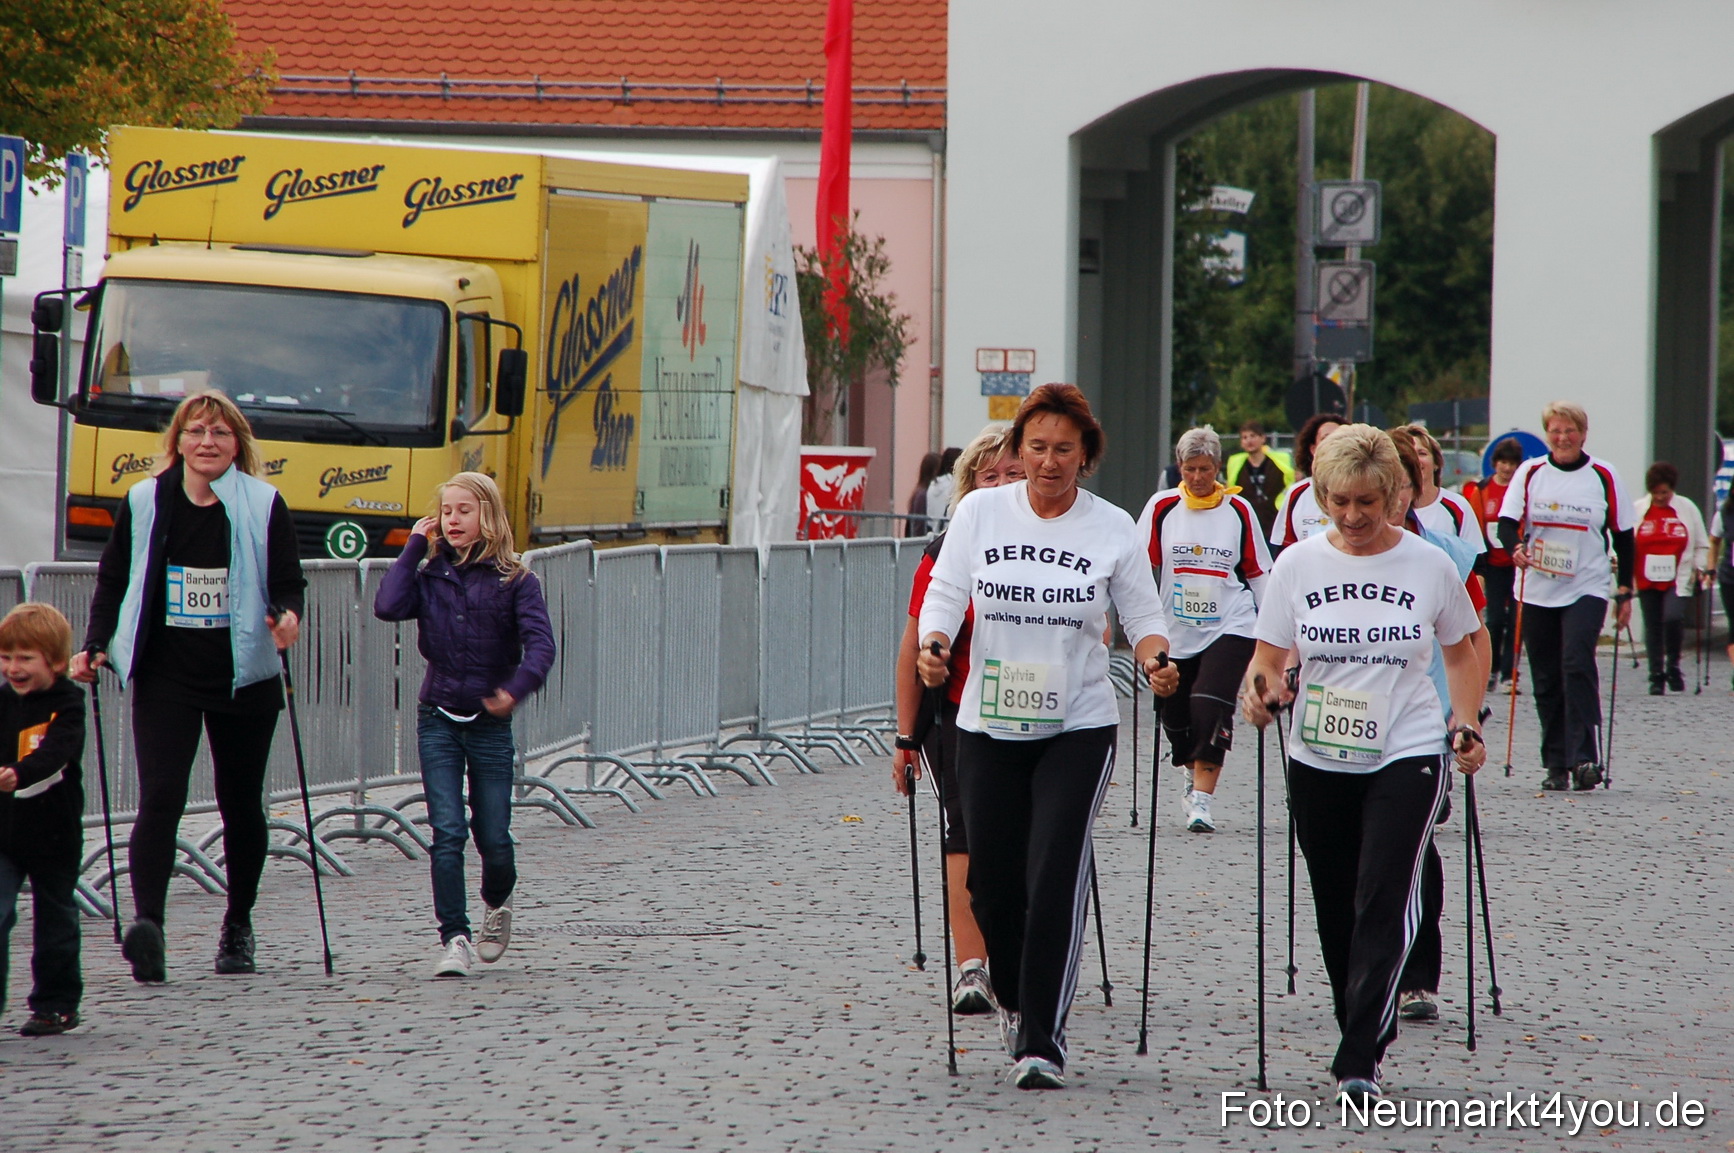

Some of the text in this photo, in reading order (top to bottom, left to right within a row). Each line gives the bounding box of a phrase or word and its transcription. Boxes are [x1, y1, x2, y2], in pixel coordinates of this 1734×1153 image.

[123, 155, 246, 212] Glossner
[263, 164, 385, 221] Glossner
[69, 166, 82, 233] P
[402, 173, 525, 229] Glossner
[541, 244, 642, 481] Glossner
[318, 463, 392, 498] Glossner
[338, 529, 357, 554] G
[984, 545, 1092, 575] BERGER
[1543, 555, 1572, 570] 8038
[186, 573, 227, 585] Barbara
[977, 579, 1096, 603] POWER GIRLS
[187, 591, 230, 608] 801
[1185, 602, 1218, 613] 8028
[1305, 583, 1416, 611] BERGER
[984, 612, 1084, 629] walking and talking
[1301, 624, 1421, 643] POWER GIRLS
[1308, 654, 1409, 669] walking and talking
[1003, 666, 1035, 683] Sylvia
[1004, 689, 1059, 710] 8095
[1326, 691, 1369, 711] Carmen
[1324, 714, 1378, 740] 8058
